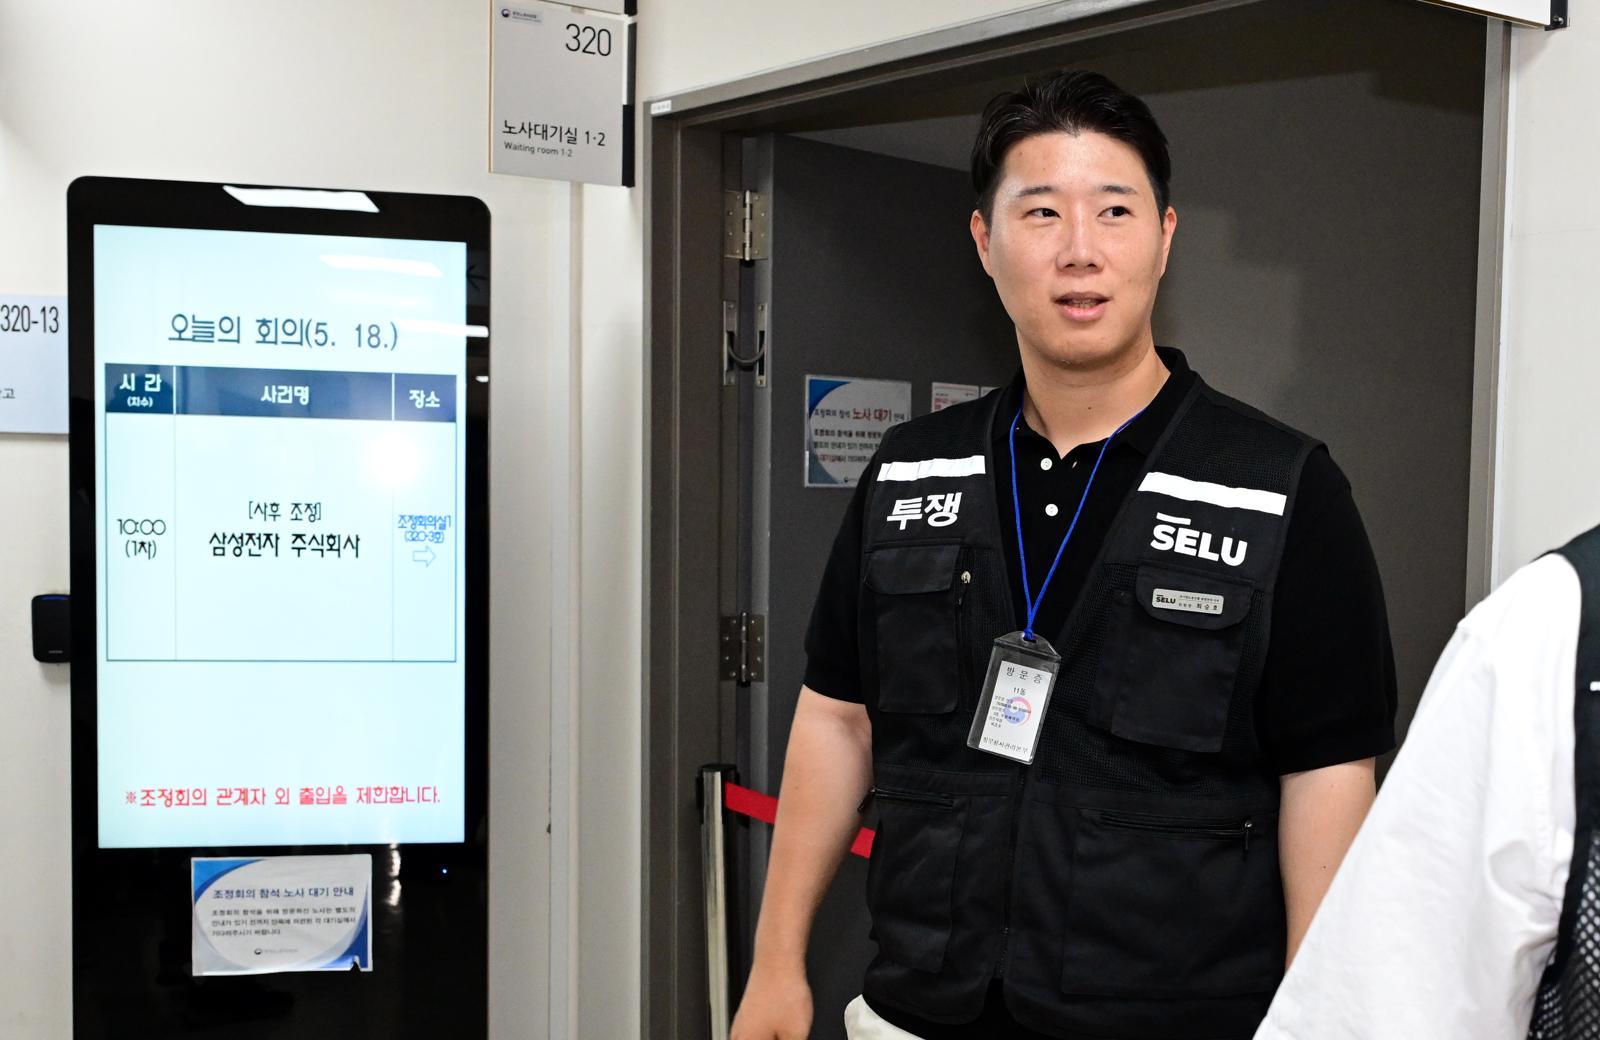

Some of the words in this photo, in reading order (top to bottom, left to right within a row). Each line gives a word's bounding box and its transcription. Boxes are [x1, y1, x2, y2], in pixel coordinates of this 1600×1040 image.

[566, 23, 611, 56] 320
[502, 119, 578, 145] 노사대기실
[504, 141, 535, 154] Waiting
[537, 146, 559, 156] room
[0, 304, 59, 333] 320-13
[168, 313, 241, 344] 오늘의
[255, 316, 336, 348] 회의(5.
[355, 321, 398, 351] 18.)
[127, 396, 153, 408] (차수)
[260, 384, 310, 406] 사건명
[409, 389, 441, 409] 장소
[852, 407, 873, 421] 노사
[874, 408, 892, 422] 대기
[249, 500, 281, 522] [사후
[290, 502, 322, 523] 조정]
[886, 491, 963, 530] 투쟁
[117, 518, 167, 536] 10:00
[125, 539, 157, 560] (1차)
[209, 532, 280, 558] 삼성전자
[291, 532, 361, 559] 주식회사
[1150, 522, 1248, 567] SELU
[1156, 596, 1176, 604] SELU
[216, 787, 267, 806] 관계자
[274, 787, 290, 806] 외
[299, 785, 348, 805] 출입을
[356, 785, 441, 805] 제한합니다.
[212, 888, 256, 900] 조정회의
[283, 887, 305, 898] 노사
[308, 886, 330, 898] 대기
[333, 886, 355, 898] 안내
